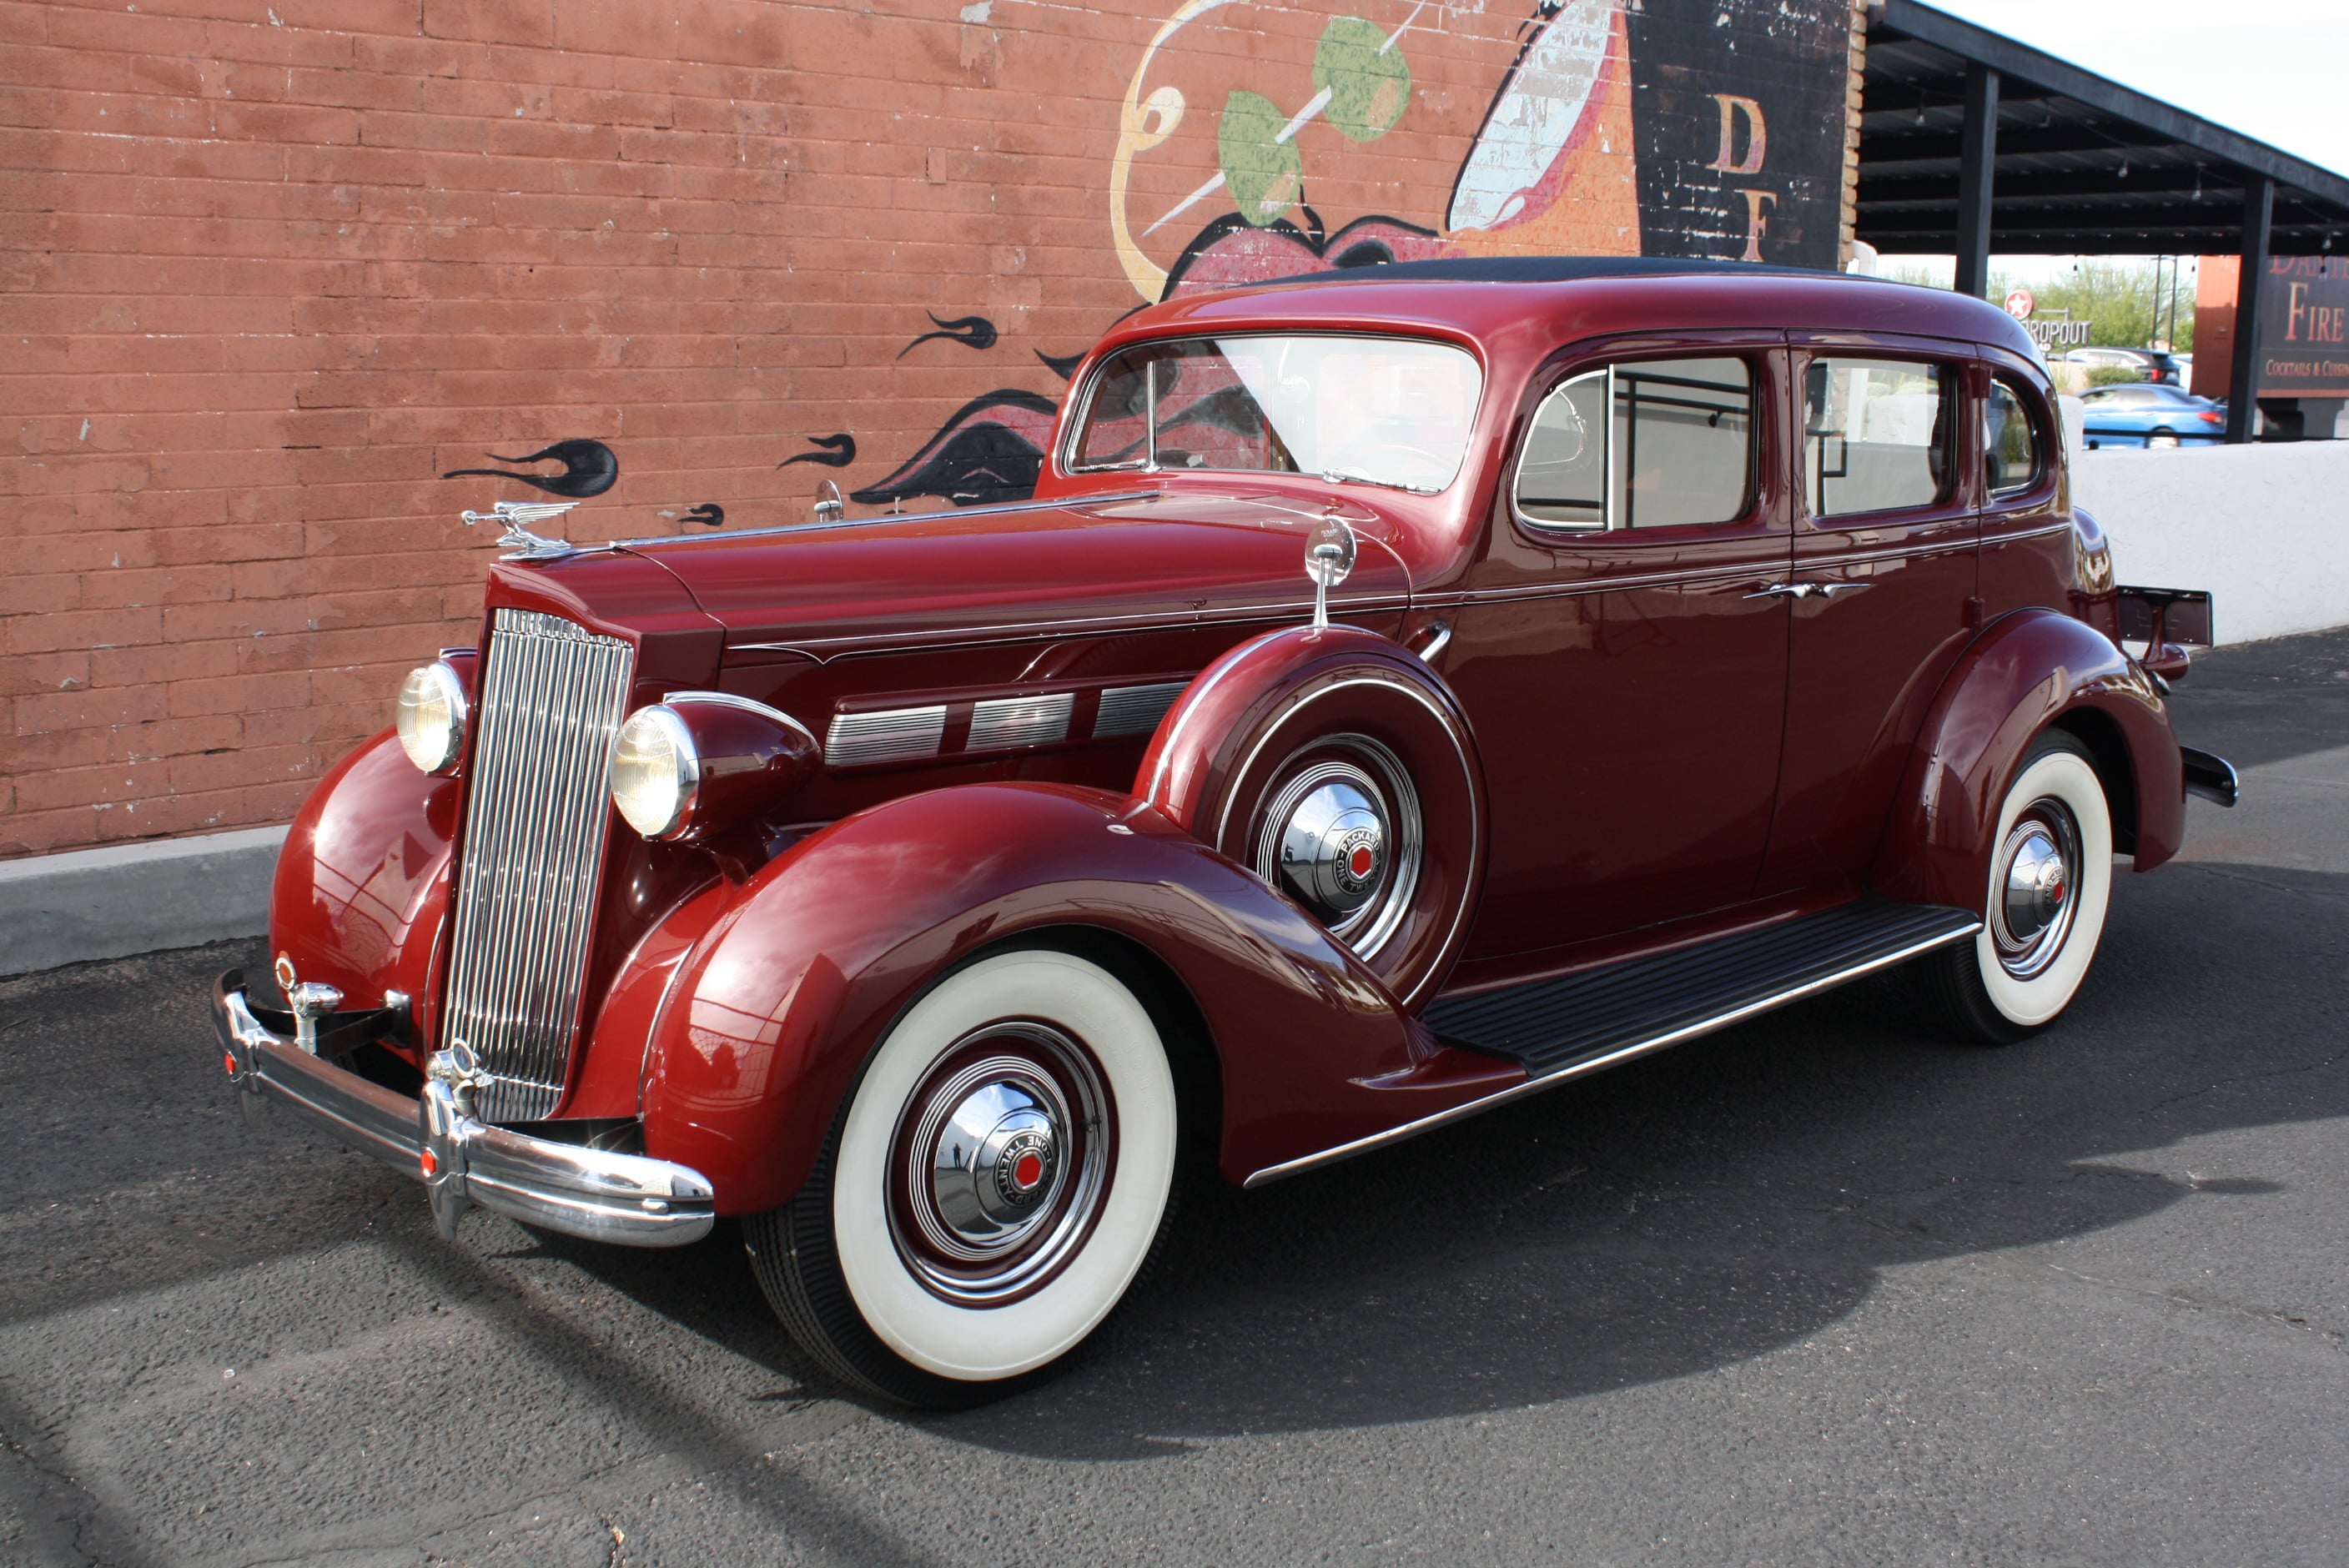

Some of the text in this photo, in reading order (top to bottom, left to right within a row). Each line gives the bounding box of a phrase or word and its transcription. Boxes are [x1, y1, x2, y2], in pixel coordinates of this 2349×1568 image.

[1706, 93, 1767, 174] D
[1740, 188, 1778, 262] F
[2284, 280, 2346, 342] FIRE
[1027, 1135, 1049, 1153] ONE
